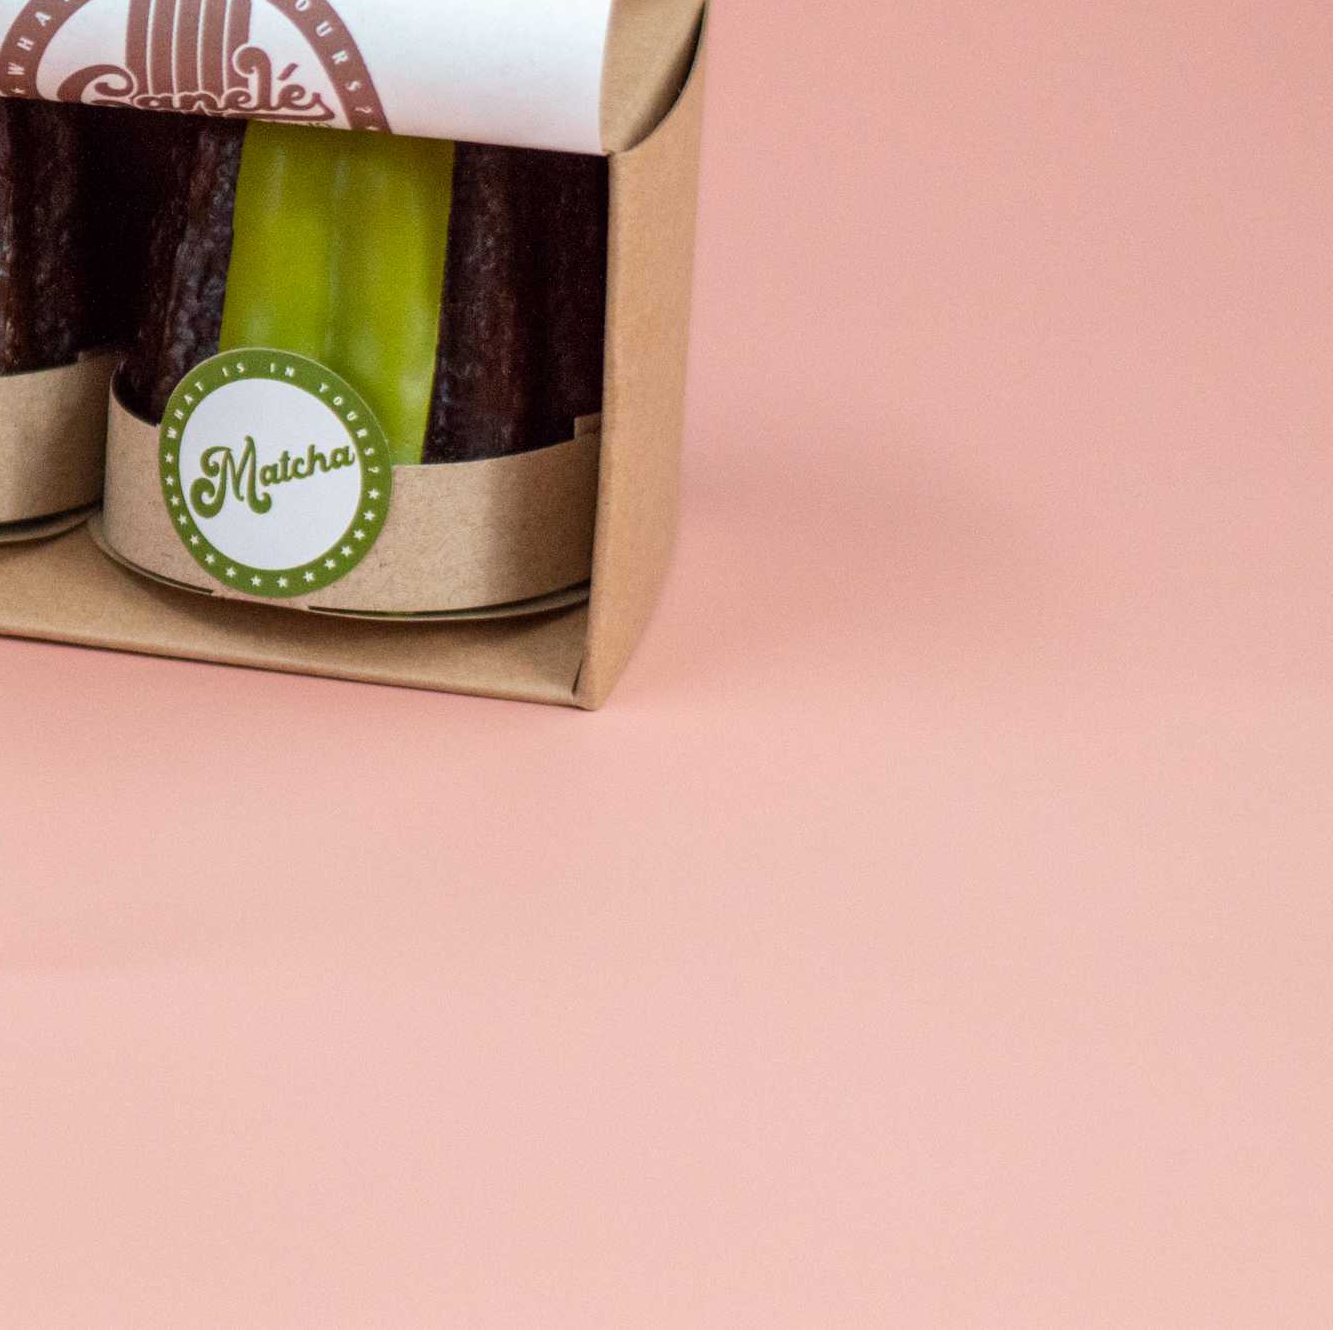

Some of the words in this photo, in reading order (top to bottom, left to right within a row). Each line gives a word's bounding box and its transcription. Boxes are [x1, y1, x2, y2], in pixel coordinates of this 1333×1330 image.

[166, 381, 204, 439] WHAT
[222, 363, 245, 377] IS
[270, 362, 296, 378] IN
[190, 434, 356, 518] Matcha
